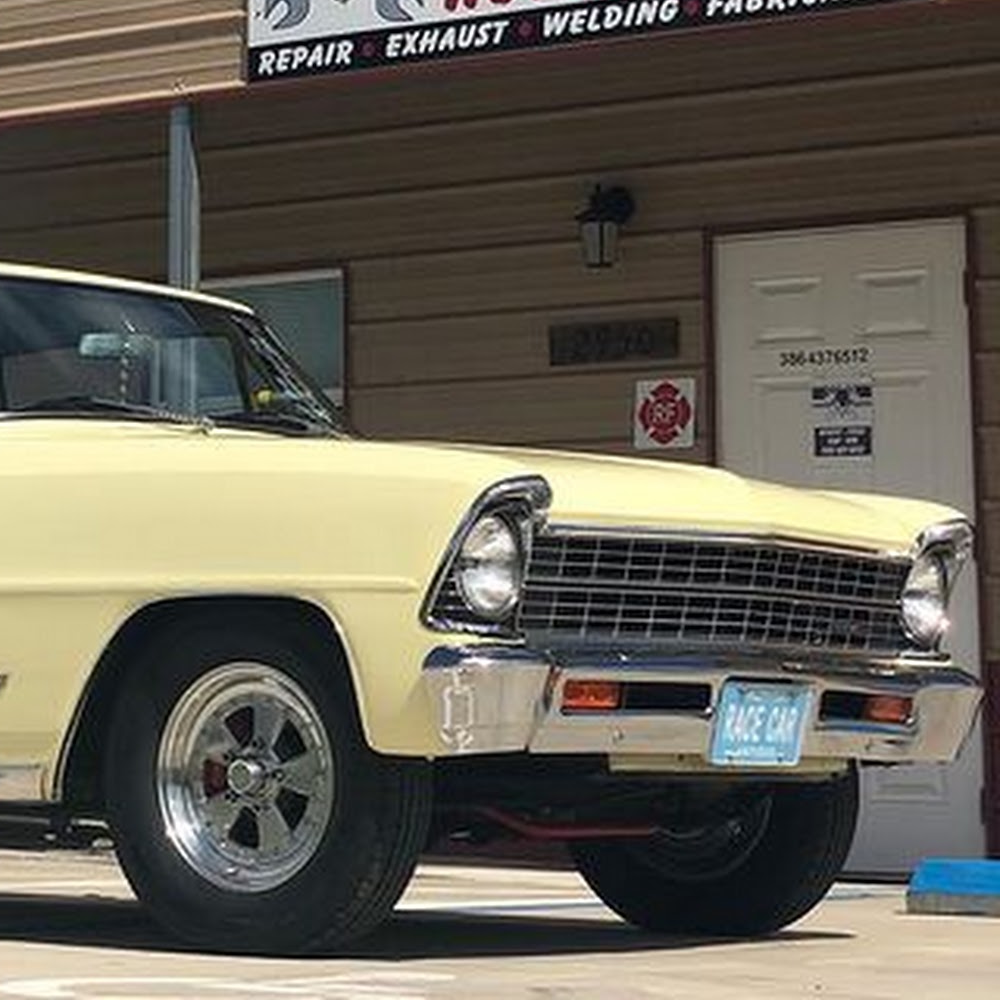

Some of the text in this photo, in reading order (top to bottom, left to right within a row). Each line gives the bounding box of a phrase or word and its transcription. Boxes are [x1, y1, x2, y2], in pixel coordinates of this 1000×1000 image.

[257, 40, 354, 77] REPAIR
[384, 20, 510, 60] EXHAUST
[541, 0, 680, 39] WELDING
